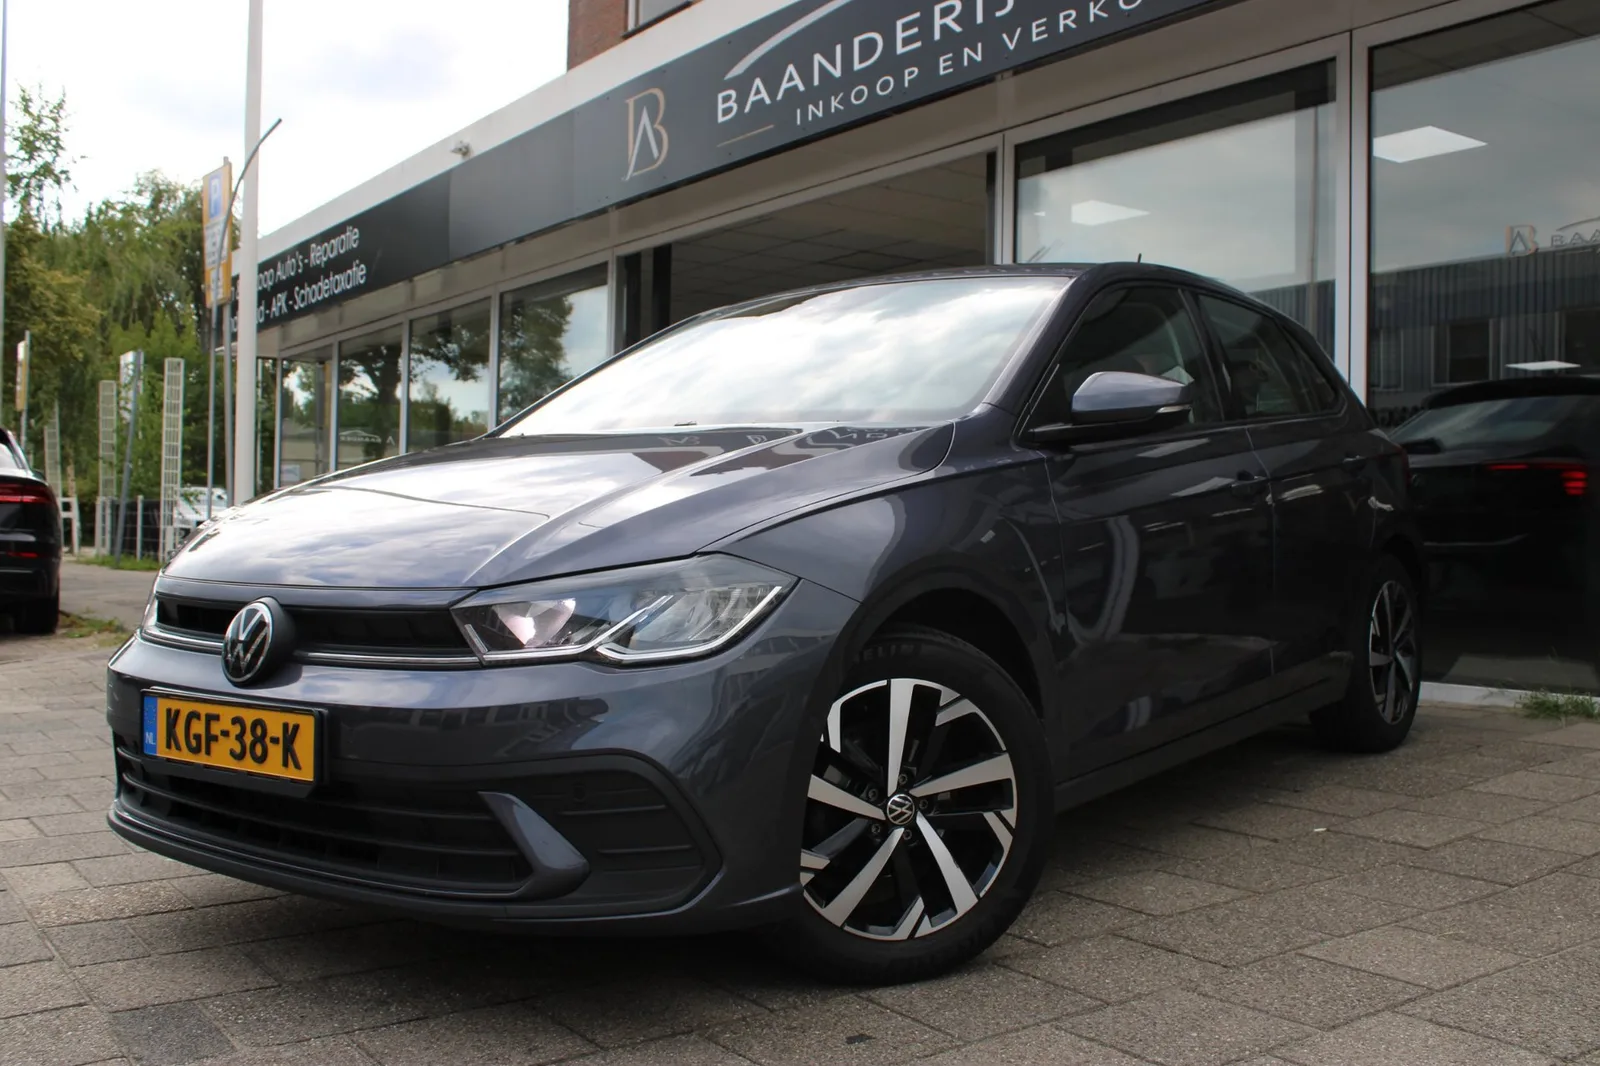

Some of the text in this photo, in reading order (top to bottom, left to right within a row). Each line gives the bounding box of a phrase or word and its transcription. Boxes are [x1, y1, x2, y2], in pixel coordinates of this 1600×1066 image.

[795, 67, 919, 126] INKOOP
[938, 42, 984, 76] EN
[275, 250, 303, 283] Auto's
[310, 225, 360, 269] Reparatie
[270, 291, 288, 318] APK
[293, 259, 367, 310] Schadetaxatie
[145, 731, 156, 746] NL
[165, 707, 302, 770] KGF-38-K
